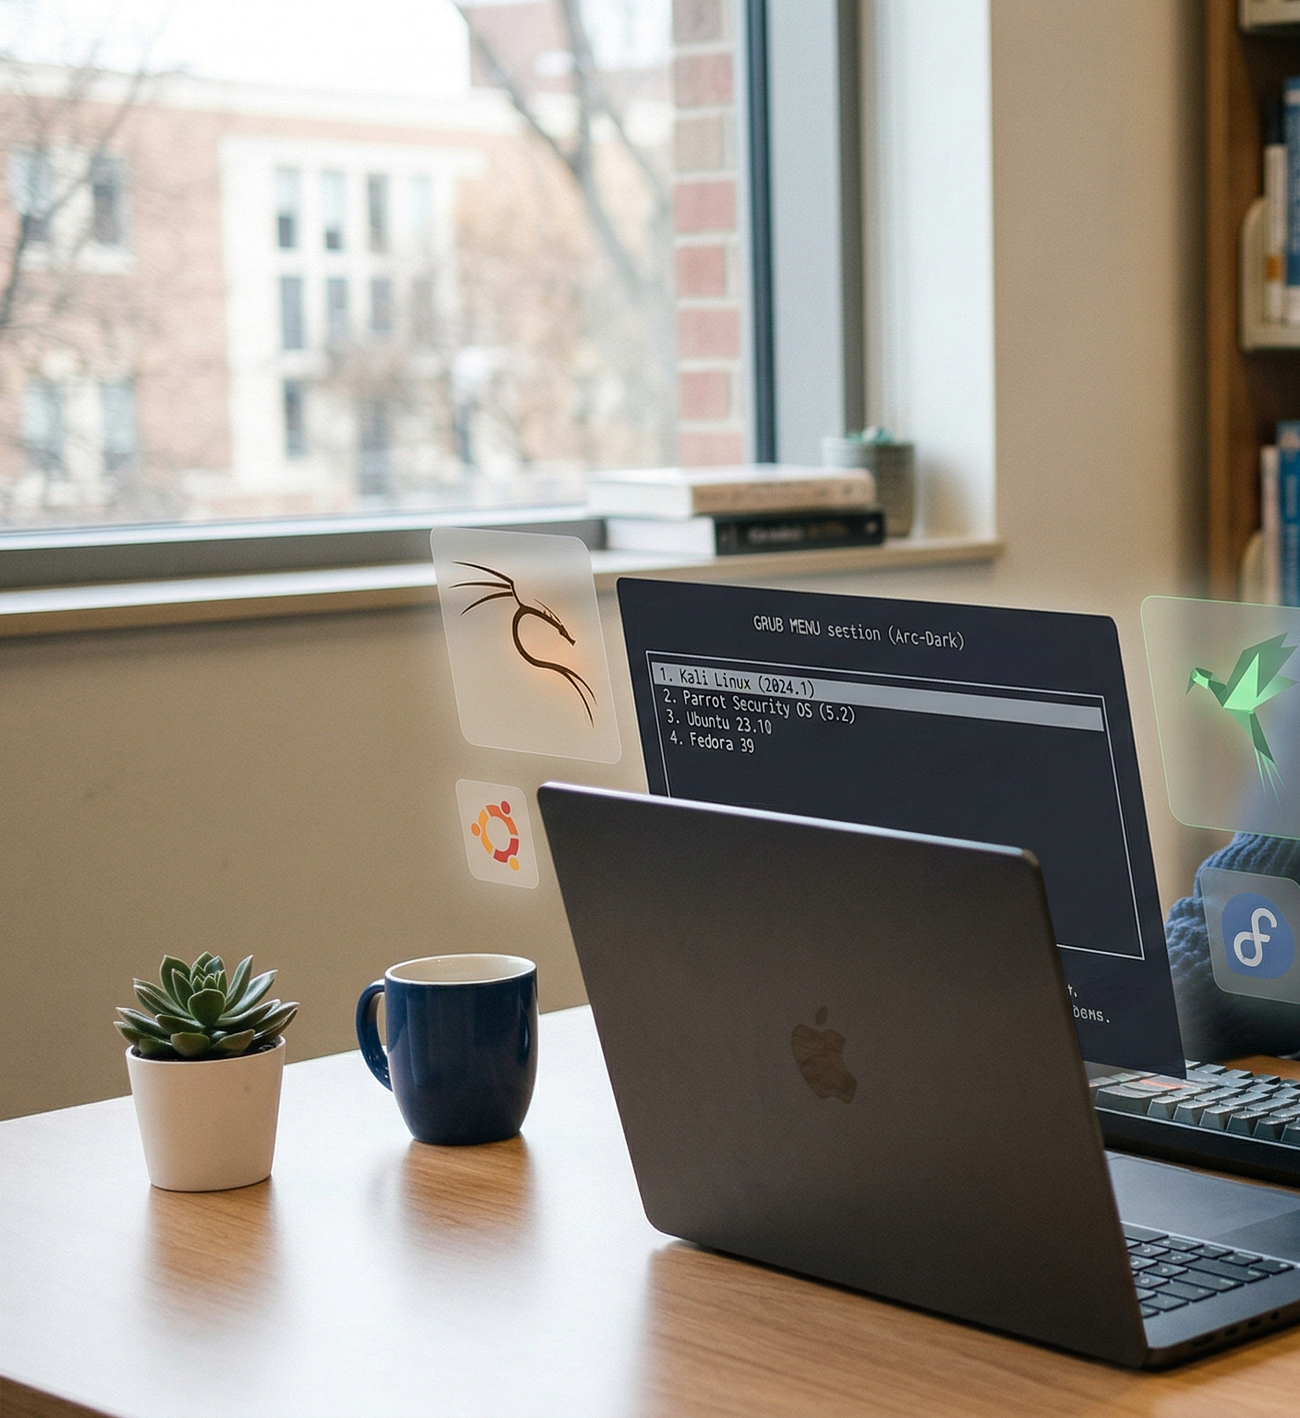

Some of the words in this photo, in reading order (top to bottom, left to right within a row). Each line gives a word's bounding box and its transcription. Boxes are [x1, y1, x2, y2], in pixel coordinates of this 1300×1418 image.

[753, 615, 784, 632] GRUB
[790, 618, 821, 636] MENU
[888, 625, 965, 651] (Arc-Dark)
[660, 667, 673, 682] 1.
[679, 668, 708, 686] Kali
[714, 672, 751, 691] Linux
[758, 675, 816, 698] (2024.1)
[663, 688, 677, 704] 2.
[683, 690, 727, 709] Parrot
[732, 692, 790, 718] Security
[796, 701, 813, 718] OS
[819, 703, 855, 724] (5.2)
[667, 708, 680, 724] 3.
[687, 710, 730, 730] Ubuntu
[735, 716, 772, 735] 23.10
[670, 730, 683, 745] 4.
[690, 732, 733, 751] Fedora
[740, 737, 755, 753] 39
